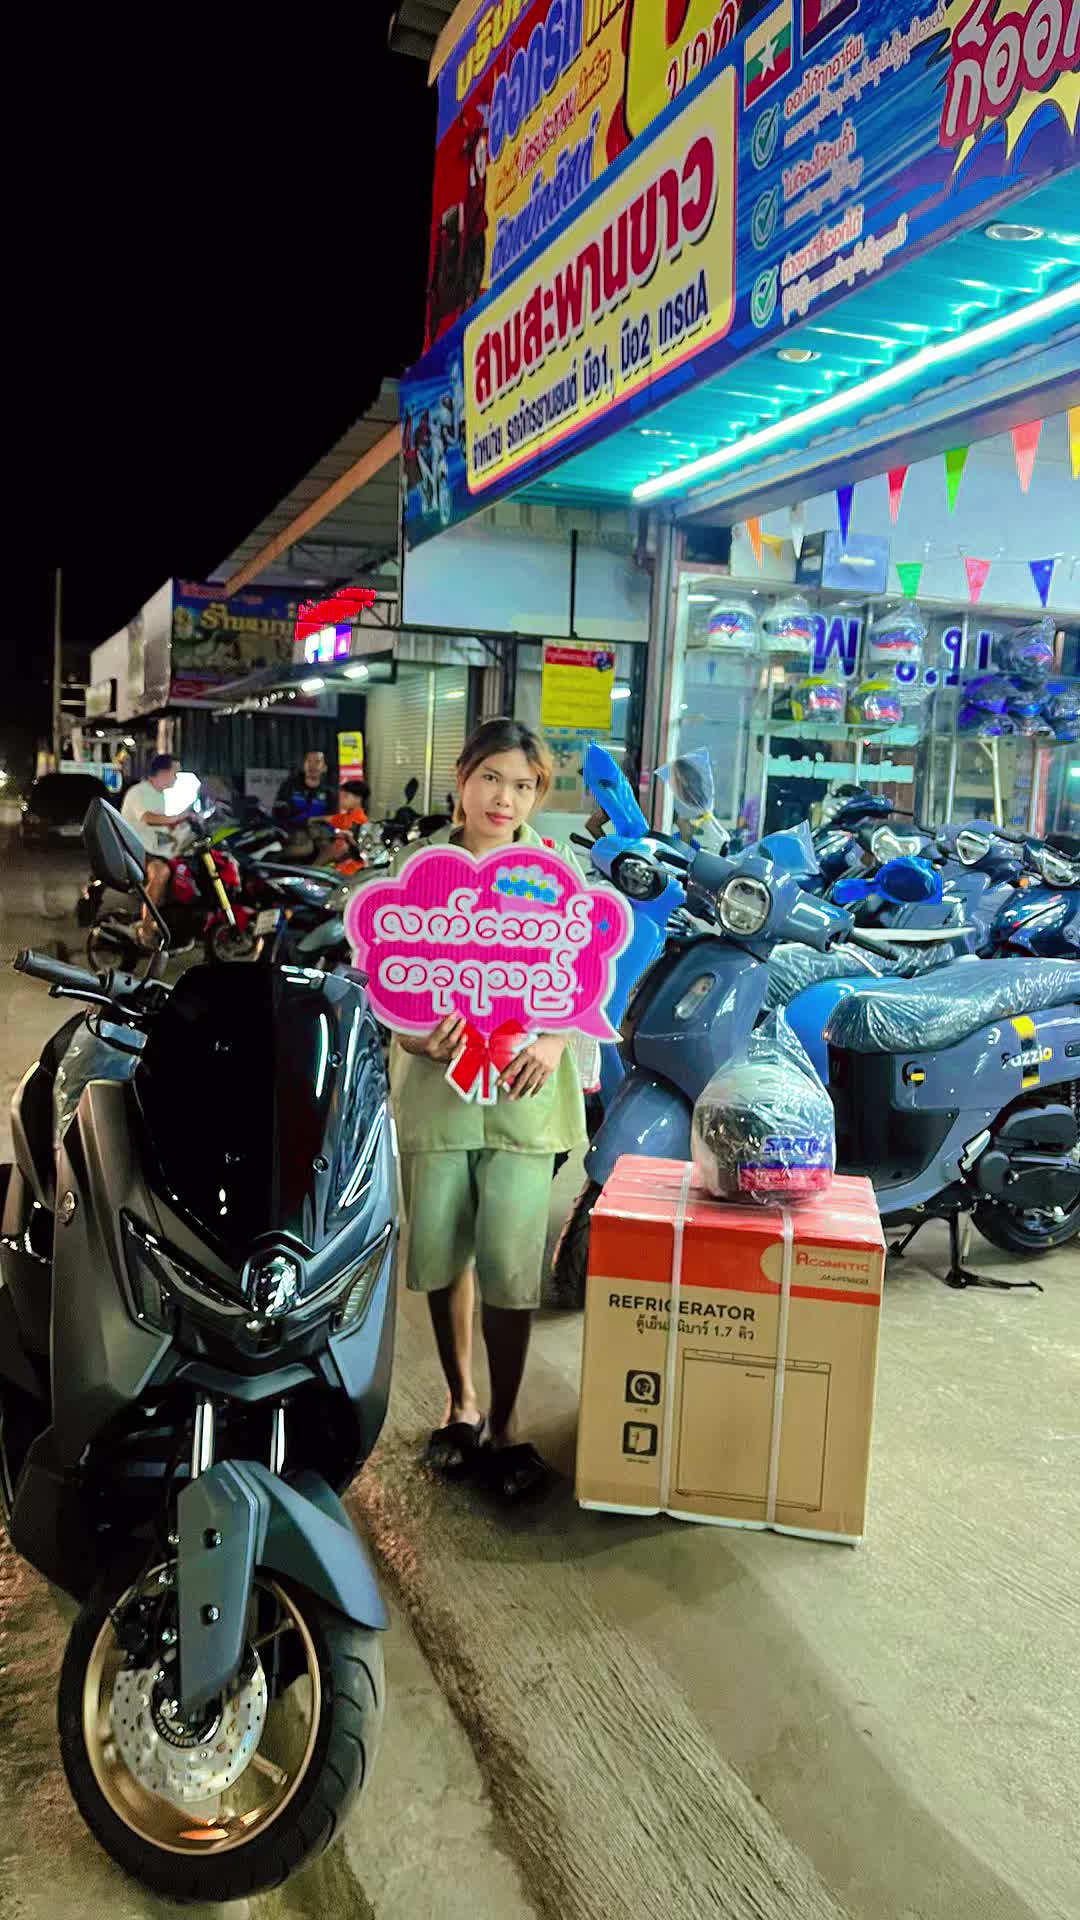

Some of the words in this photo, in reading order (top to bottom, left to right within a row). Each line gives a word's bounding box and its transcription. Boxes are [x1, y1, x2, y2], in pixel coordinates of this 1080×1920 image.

[475, 136, 714, 405] สามสะพานขาว
[473, 422, 502, 470] จำหน่าย
[507, 357, 577, 449] รถจักรยานยนต์
[621, 313, 649, 372] มือ2
[659, 269, 708, 347] เกรดA
[377, 890, 591, 947] လက်ဆောင်
[384, 949, 575, 1013] တခုရသည်
[714, 1325, 732, 1337] 1.7
